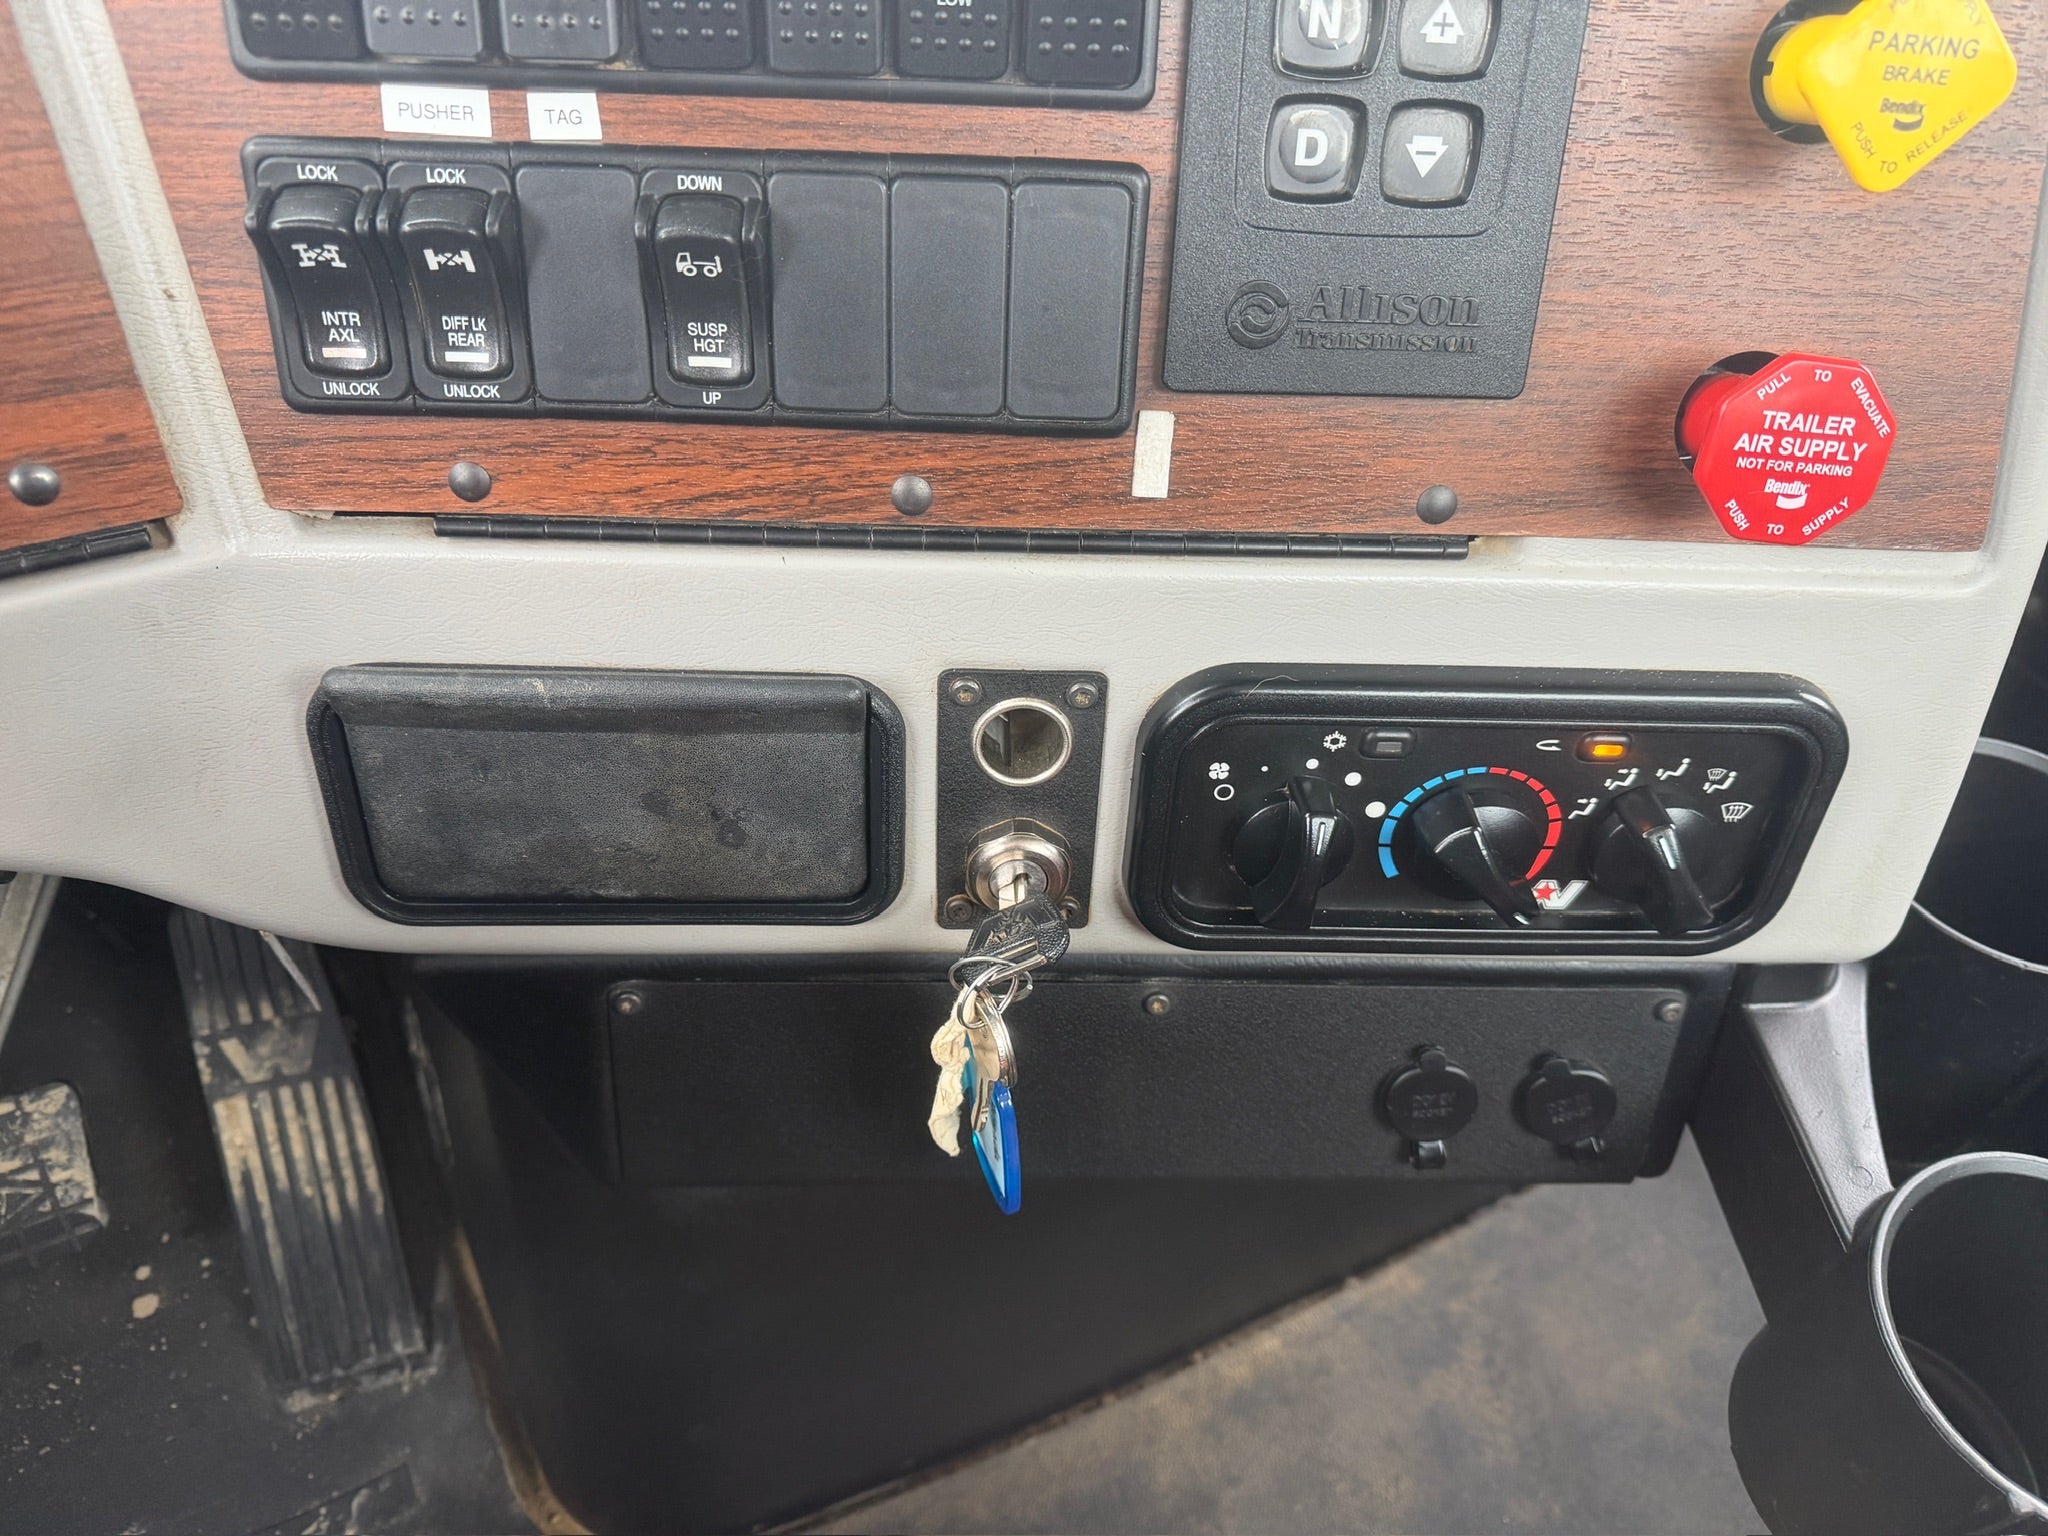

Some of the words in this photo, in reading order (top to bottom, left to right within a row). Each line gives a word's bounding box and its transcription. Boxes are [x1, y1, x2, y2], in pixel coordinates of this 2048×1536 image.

[1307, 0, 1342, 39] N
[1868, 30, 1980, 60] PARKING
[1882, 64, 1951, 86] BRAKE
[398, 101, 474, 121] PUSHER
[1879, 97, 1926, 115] Bendix
[544, 109, 583, 125] TAG
[1294, 128, 1328, 167] D
[1850, 120, 1877, 159] PUSH
[1879, 159, 1898, 174] TO
[1904, 110, 1968, 162] RELEASE
[296, 164, 338, 181] LOCK
[425, 167, 467, 185] LOCK
[677, 174, 722, 191] DOWN
[1297, 284, 1480, 327] Allison
[321, 311, 361, 327] INTR
[441, 315, 469, 331] DIFF
[471, 317, 488, 332] LK
[328, 328, 361, 342] AXL
[687, 321, 728, 337] SUSP
[448, 332, 485, 347] REAR
[693, 338, 725, 353] HGT
[1295, 328, 1477, 353] Transmission
[322, 381, 381, 396] UNLOCK
[443, 384, 501, 399] UNLOCK
[702, 391, 722, 405] UP
[1756, 372, 1791, 401] PULL
[1814, 369, 1832, 383] TO
[1850, 376, 1891, 438] EVACUATE
[1762, 410, 1856, 437] TRAILER
[1733, 432, 1775, 454] AIR
[1778, 437, 1868, 462] SUPPLY
[1735, 456, 1765, 470] NOT
[1765, 460, 1794, 474] FOR
[1795, 462, 1853, 478] PARKING
[1764, 478, 1808, 496] Bendix
[1724, 498, 1750, 532] PUSH
[1766, 523, 1785, 536] TO
[1801, 496, 1849, 536] SUPPLY
